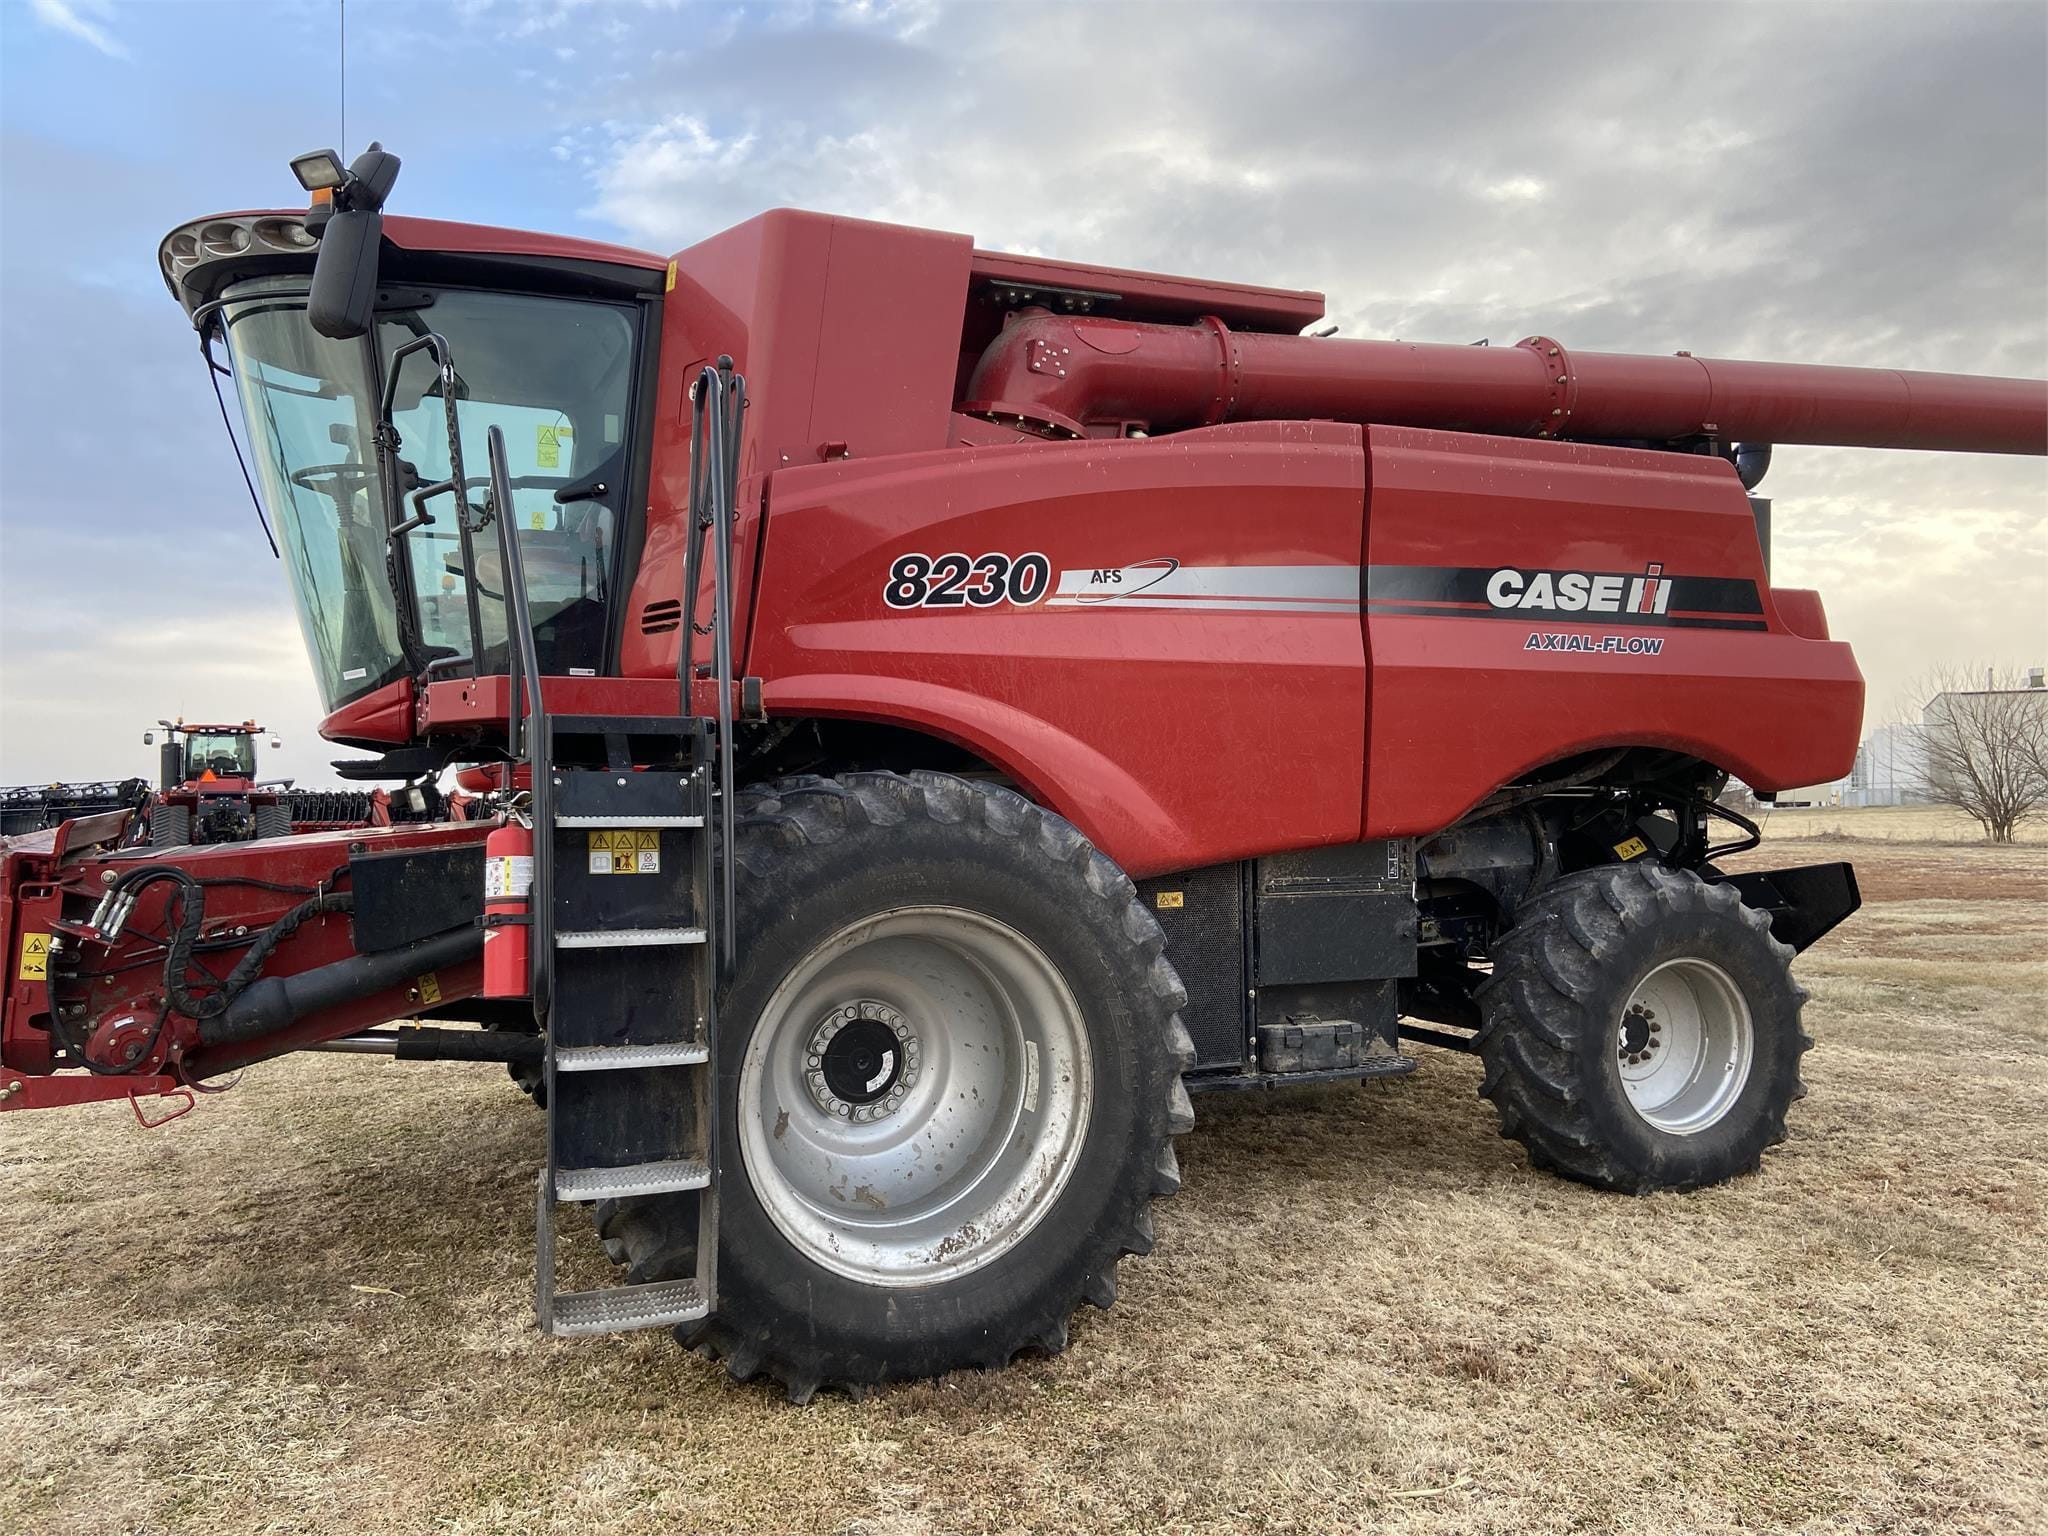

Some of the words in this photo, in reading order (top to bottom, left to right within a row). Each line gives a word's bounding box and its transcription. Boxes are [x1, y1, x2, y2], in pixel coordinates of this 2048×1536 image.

[884, 552, 1049, 608] 8230
[1090, 569, 1122, 584] AFS
[1486, 569, 1625, 612] CASE
[1525, 633, 1664, 655] AXIAL-FLOW
